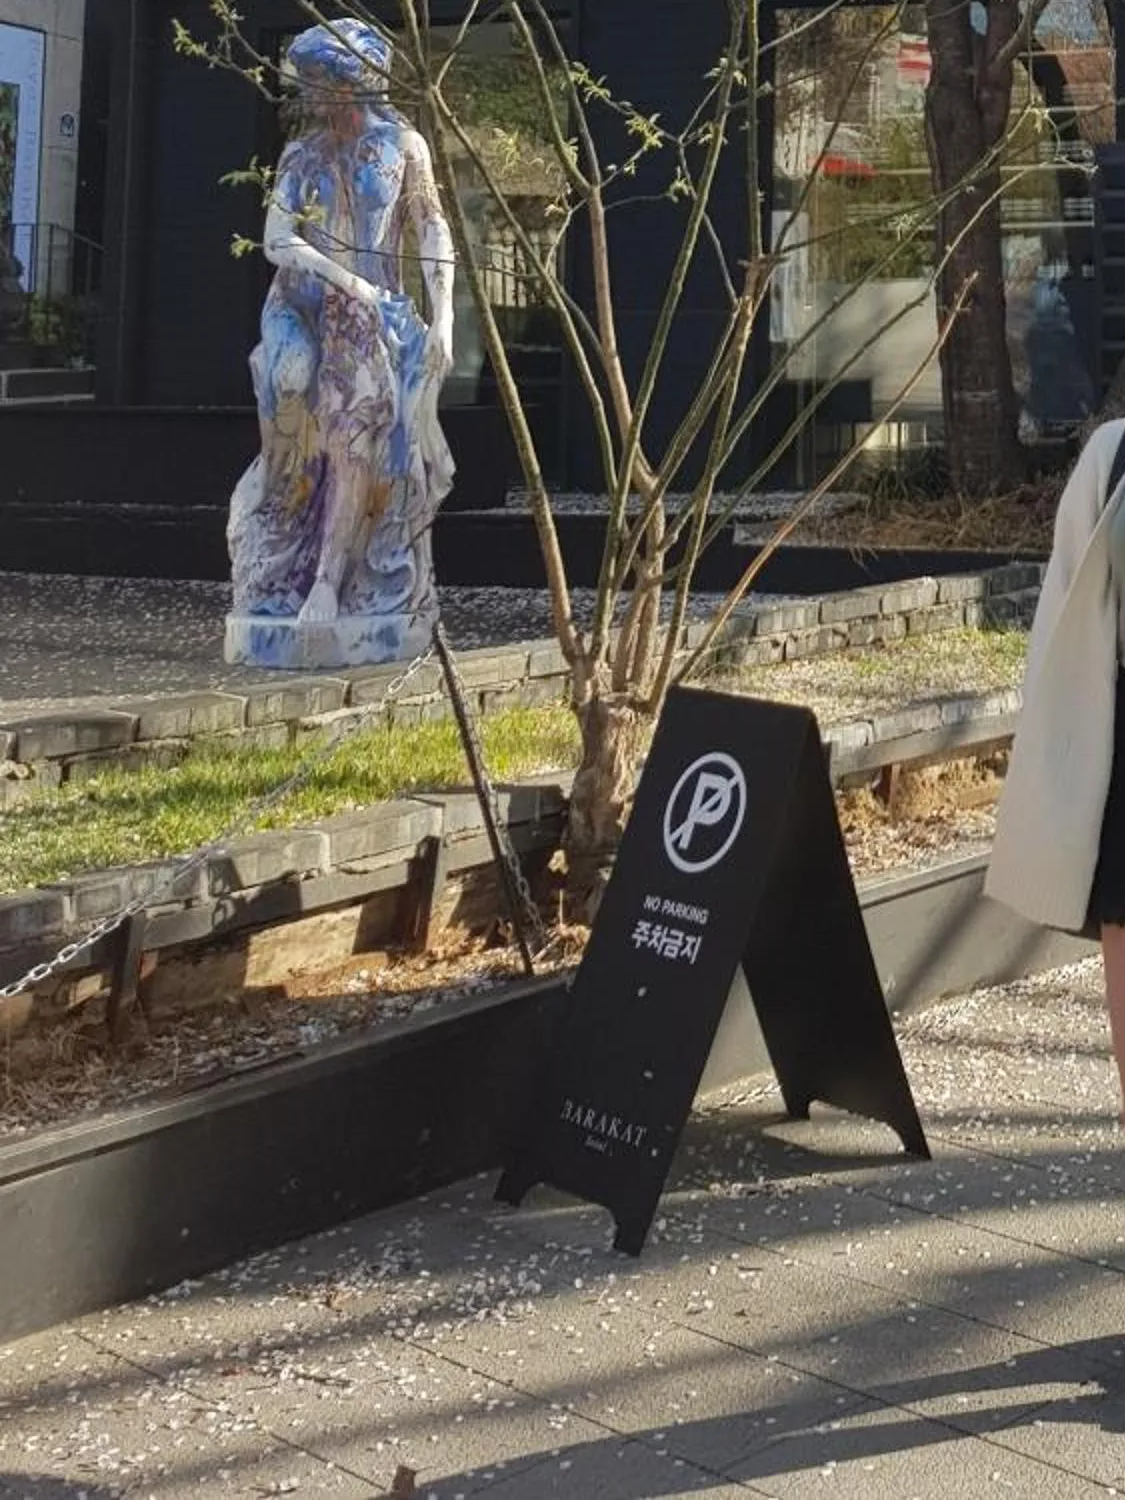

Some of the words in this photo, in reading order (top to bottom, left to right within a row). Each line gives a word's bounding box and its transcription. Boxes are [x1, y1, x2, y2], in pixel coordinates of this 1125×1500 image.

[643, 894, 661, 912] NO
[661, 899, 709, 925] PARKING
[632, 920, 702, 965] 주차금지
